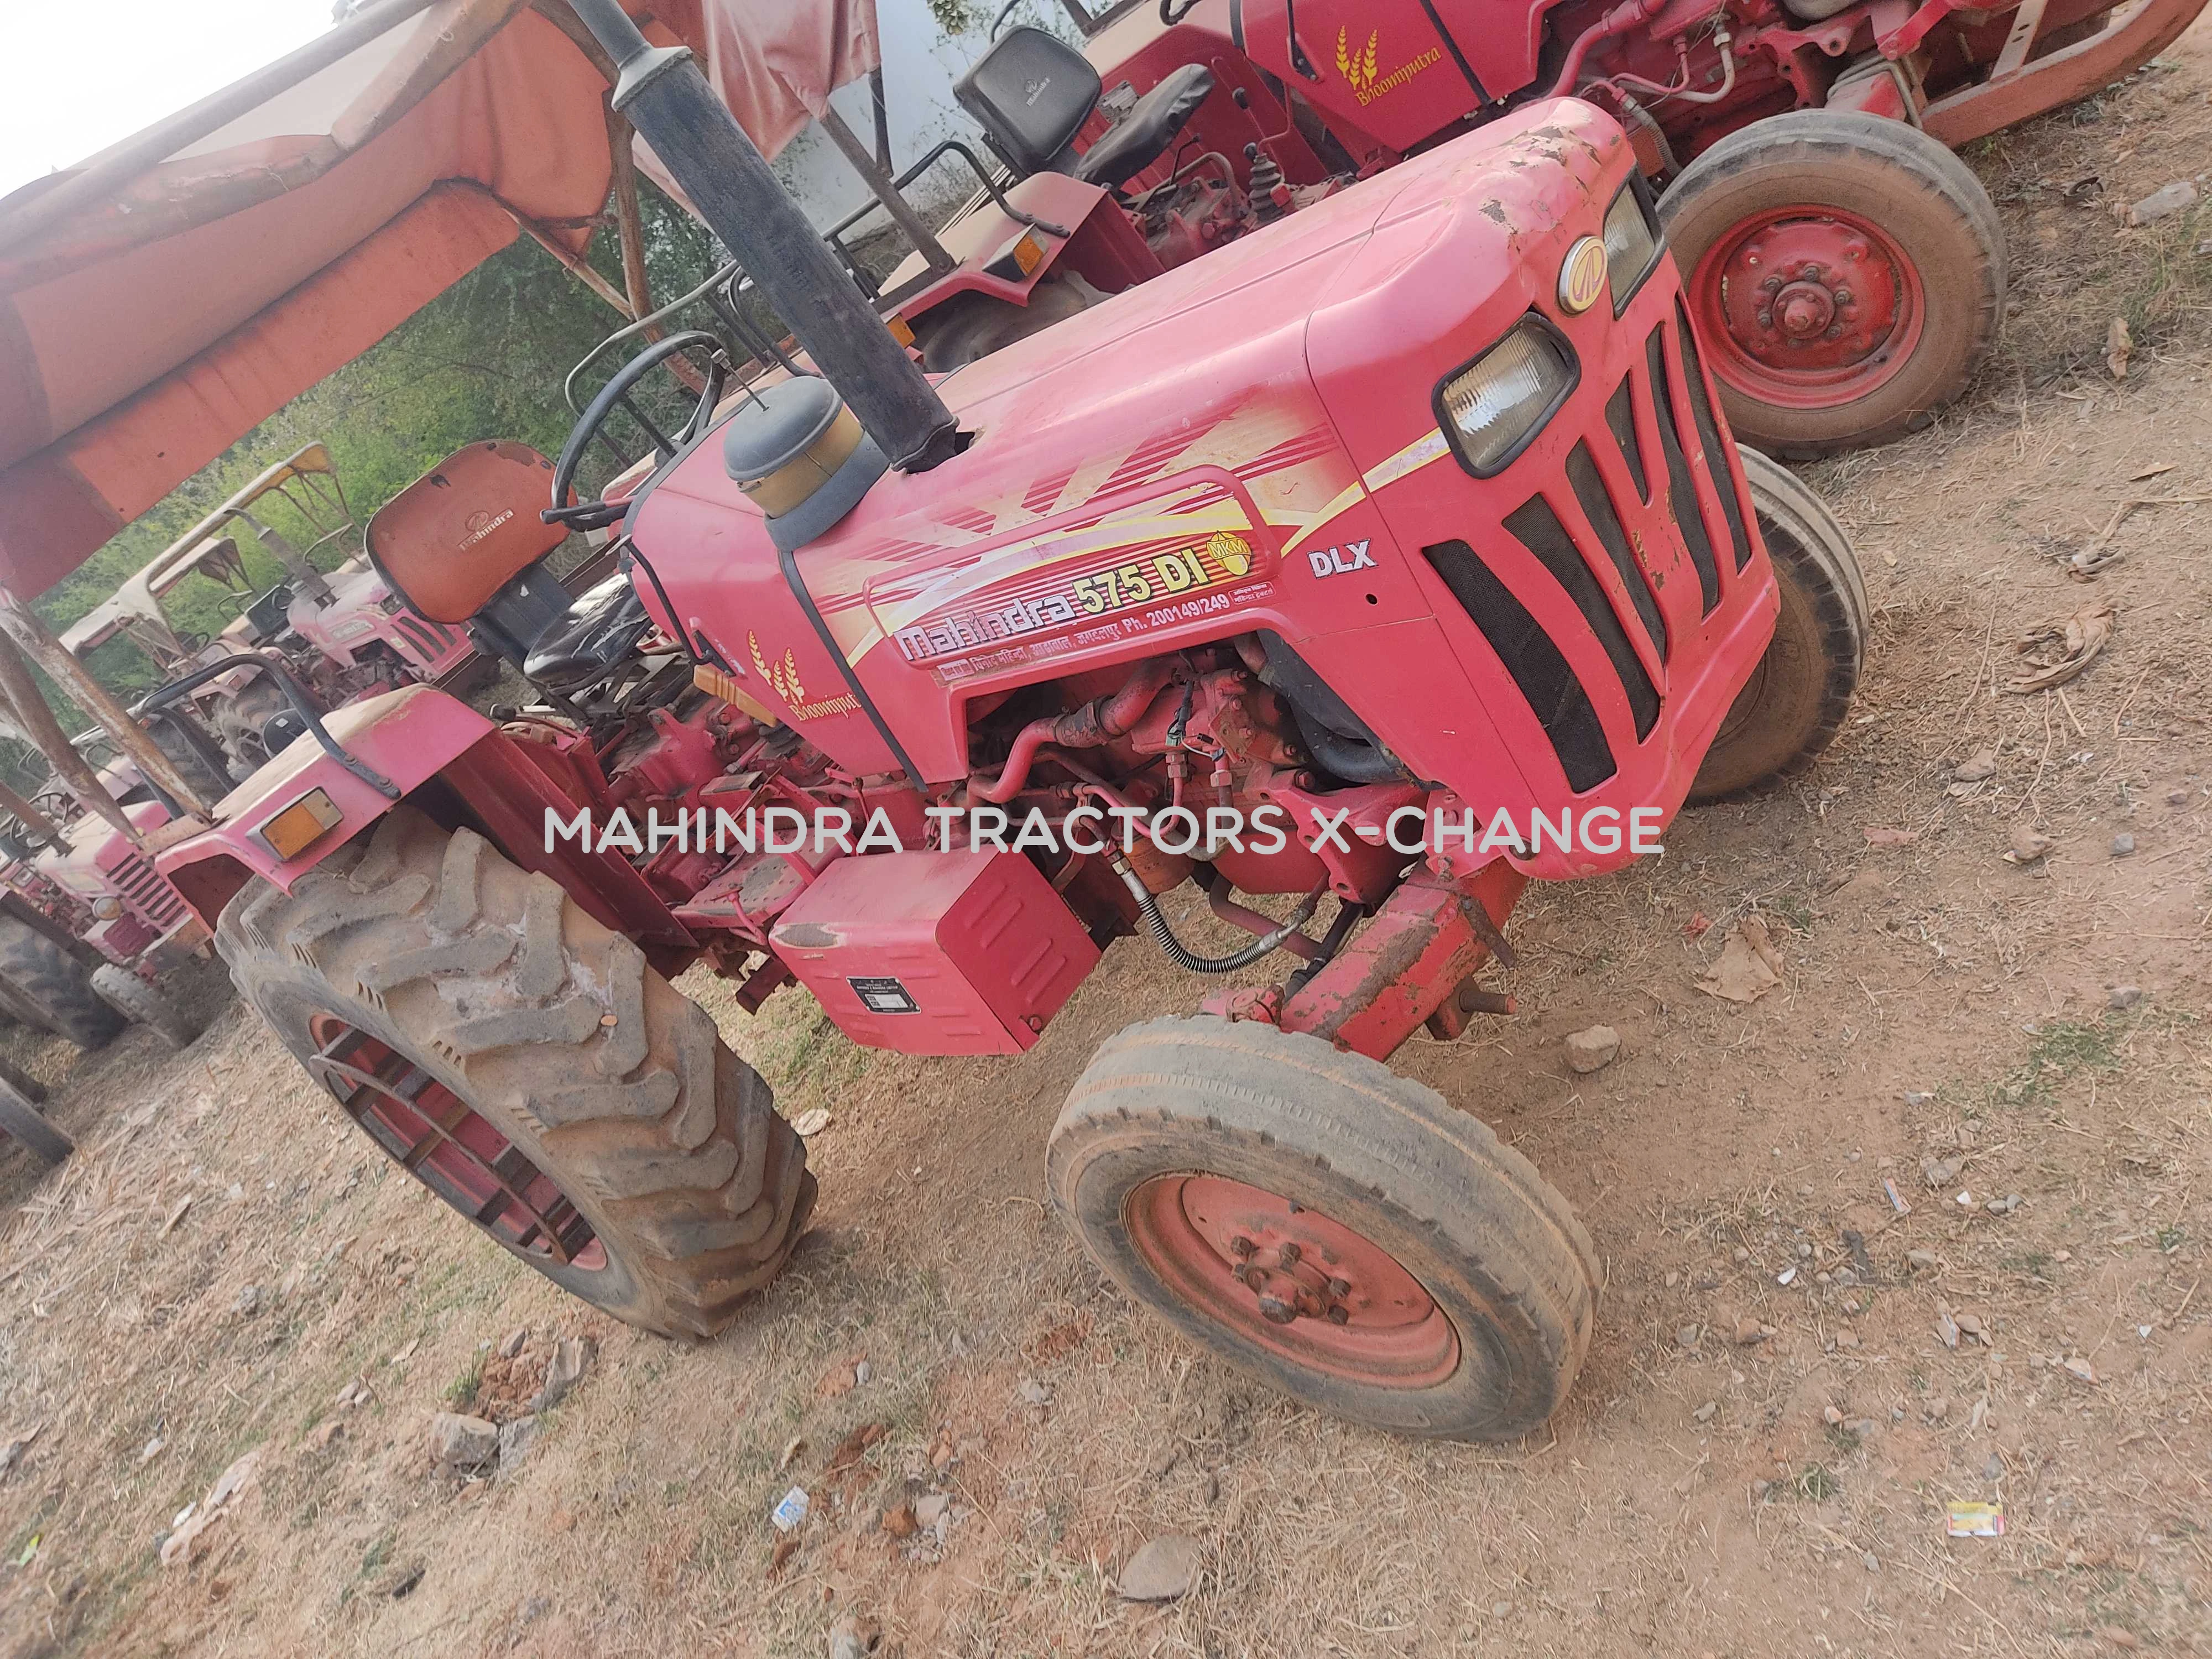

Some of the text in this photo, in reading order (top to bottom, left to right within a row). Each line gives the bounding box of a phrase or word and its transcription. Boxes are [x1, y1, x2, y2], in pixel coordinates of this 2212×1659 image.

[1355, 47, 1442, 107] Bhoomiputra
[1307, 538, 1380, 579] DLX
[1072, 564, 1152, 614] 575
[1150, 546, 1212, 593] DI
[1121, 616, 1148, 634] Ph.
[1146, 593, 1231, 628] 200149/249
[787, 692, 862, 722] Bhoomiput
